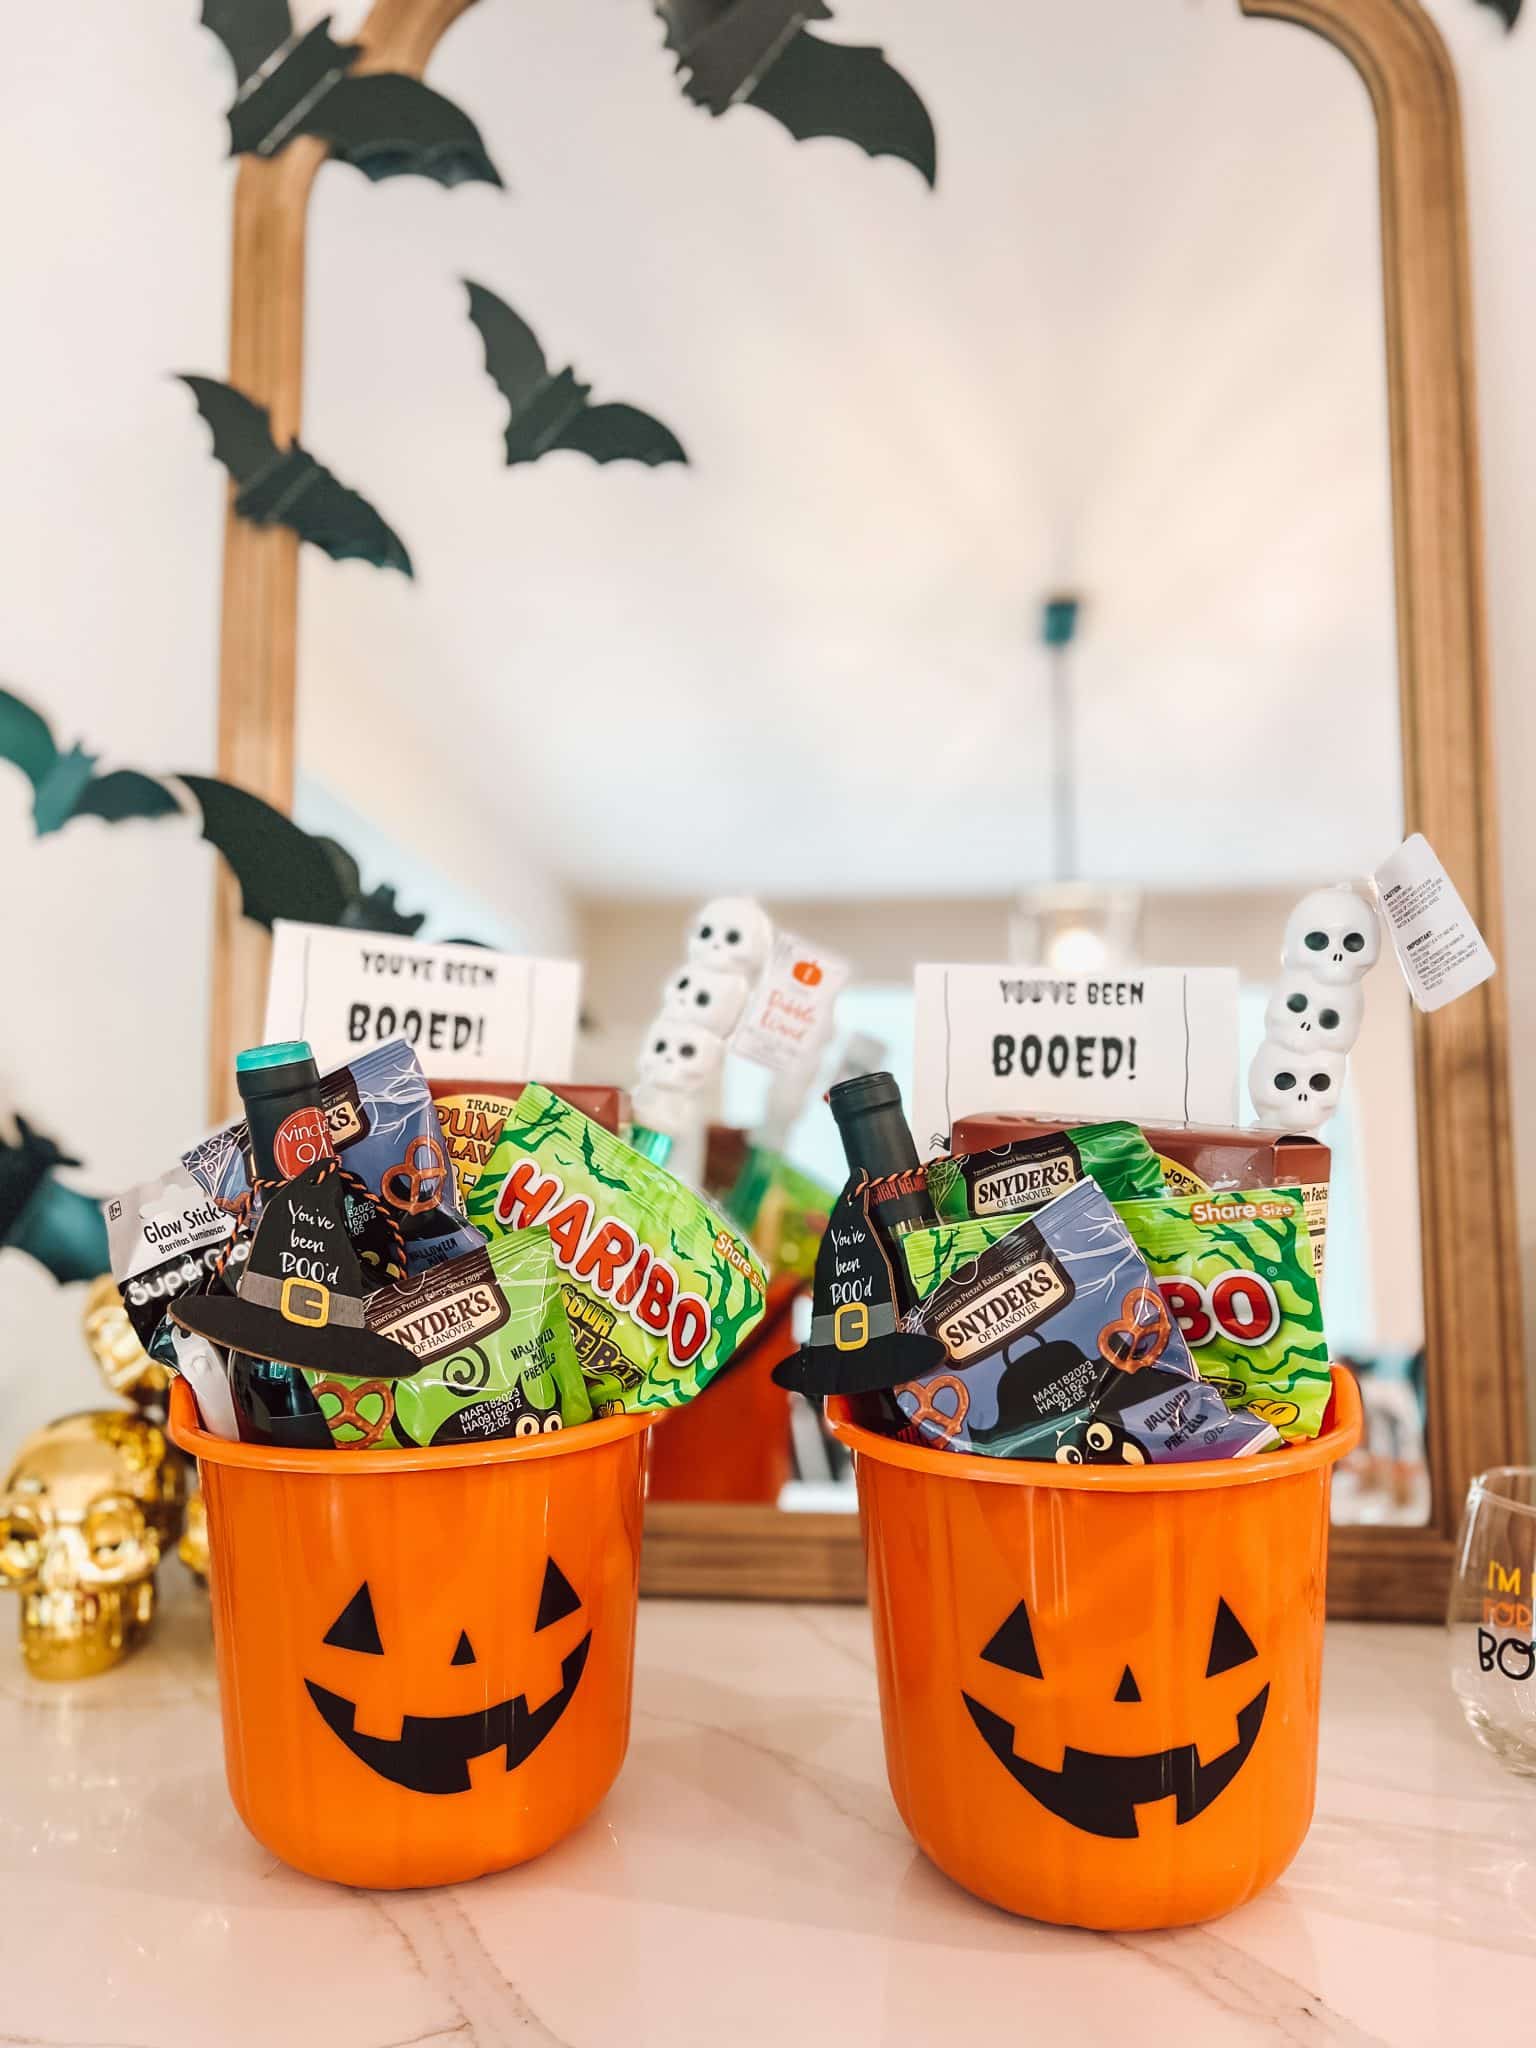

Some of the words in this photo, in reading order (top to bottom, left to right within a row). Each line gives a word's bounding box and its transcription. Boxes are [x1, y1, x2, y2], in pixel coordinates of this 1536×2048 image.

[1086, 981, 1145, 1006] BEEN
[348, 1002, 485, 1056] BOOED!
[992, 1034, 1137, 1080] BOOED!
[444, 1136, 495, 1166] LAV
[978, 1161, 1069, 1204] SNYDER'S
[996, 1199, 1009, 1209] OF
[1010, 1187, 1053, 1206] HANOVER
[1164, 1168, 1201, 1195] JOE'S
[288, 1199, 335, 1231] You've
[1192, 1202, 1257, 1222] Share
[1261, 1204, 1294, 1216] Size
[143, 1220, 183, 1244] Glow
[290, 1228, 326, 1253] been
[830, 1225, 866, 1254] You've
[279, 1252, 340, 1285] BOO'd
[498, 1162, 708, 1363] HARIBO
[716, 1234, 752, 1276] Share
[835, 1256, 861, 1277] been
[829, 1275, 873, 1306] BOO'd
[960, 1282, 983, 1302] Pretzel
[562, 1284, 616, 1338] SOUR
[946, 1268, 1053, 1348] SNYDER'S
[978, 1331, 991, 1344] OF
[991, 1301, 1041, 1336] HANOVER
[412, 1340, 427, 1355] OF
[428, 1320, 476, 1348] HANOVER
[1033, 1360, 1094, 1404] MAR182023
[1036, 1375, 1089, 1415] HA091620
[459, 1387, 520, 1425] MAR182023
[1058, 1388, 1087, 1412] 22:05
[461, 1402, 514, 1435] HA091620
[482, 1416, 511, 1436] 22:05
[1487, 1560, 1522, 1596] I'M
